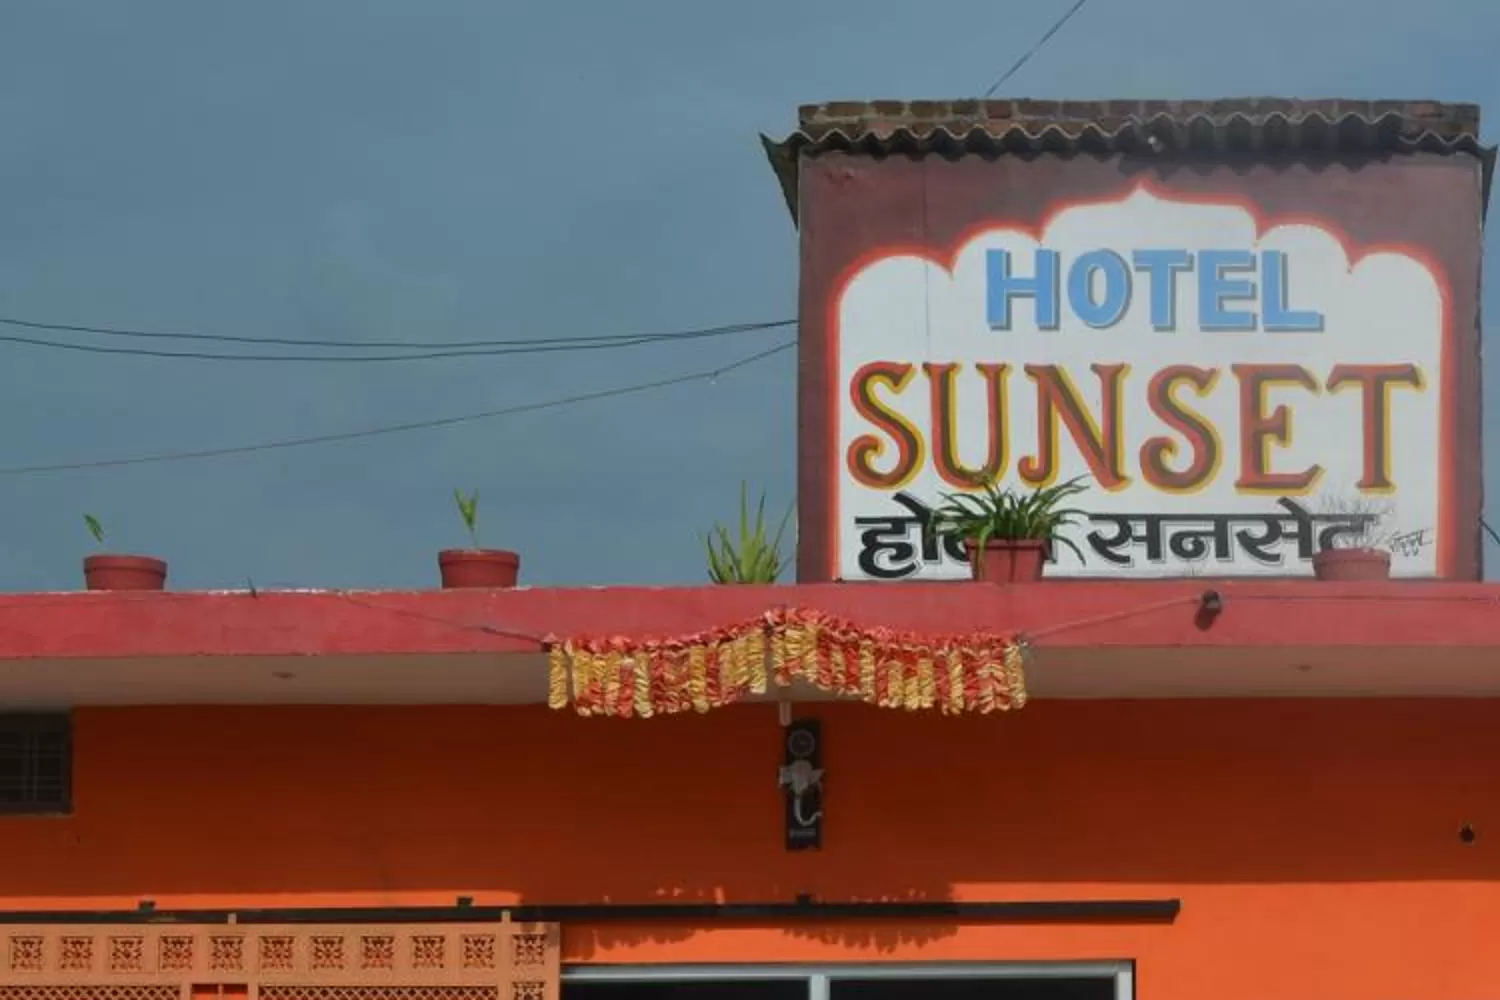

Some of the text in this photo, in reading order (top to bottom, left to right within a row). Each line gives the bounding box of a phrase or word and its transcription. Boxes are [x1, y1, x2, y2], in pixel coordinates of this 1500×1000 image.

[984, 246, 1325, 333] HOTEL
[846, 360, 1427, 495] SUNSET
[855, 490, 1057, 579] हो
